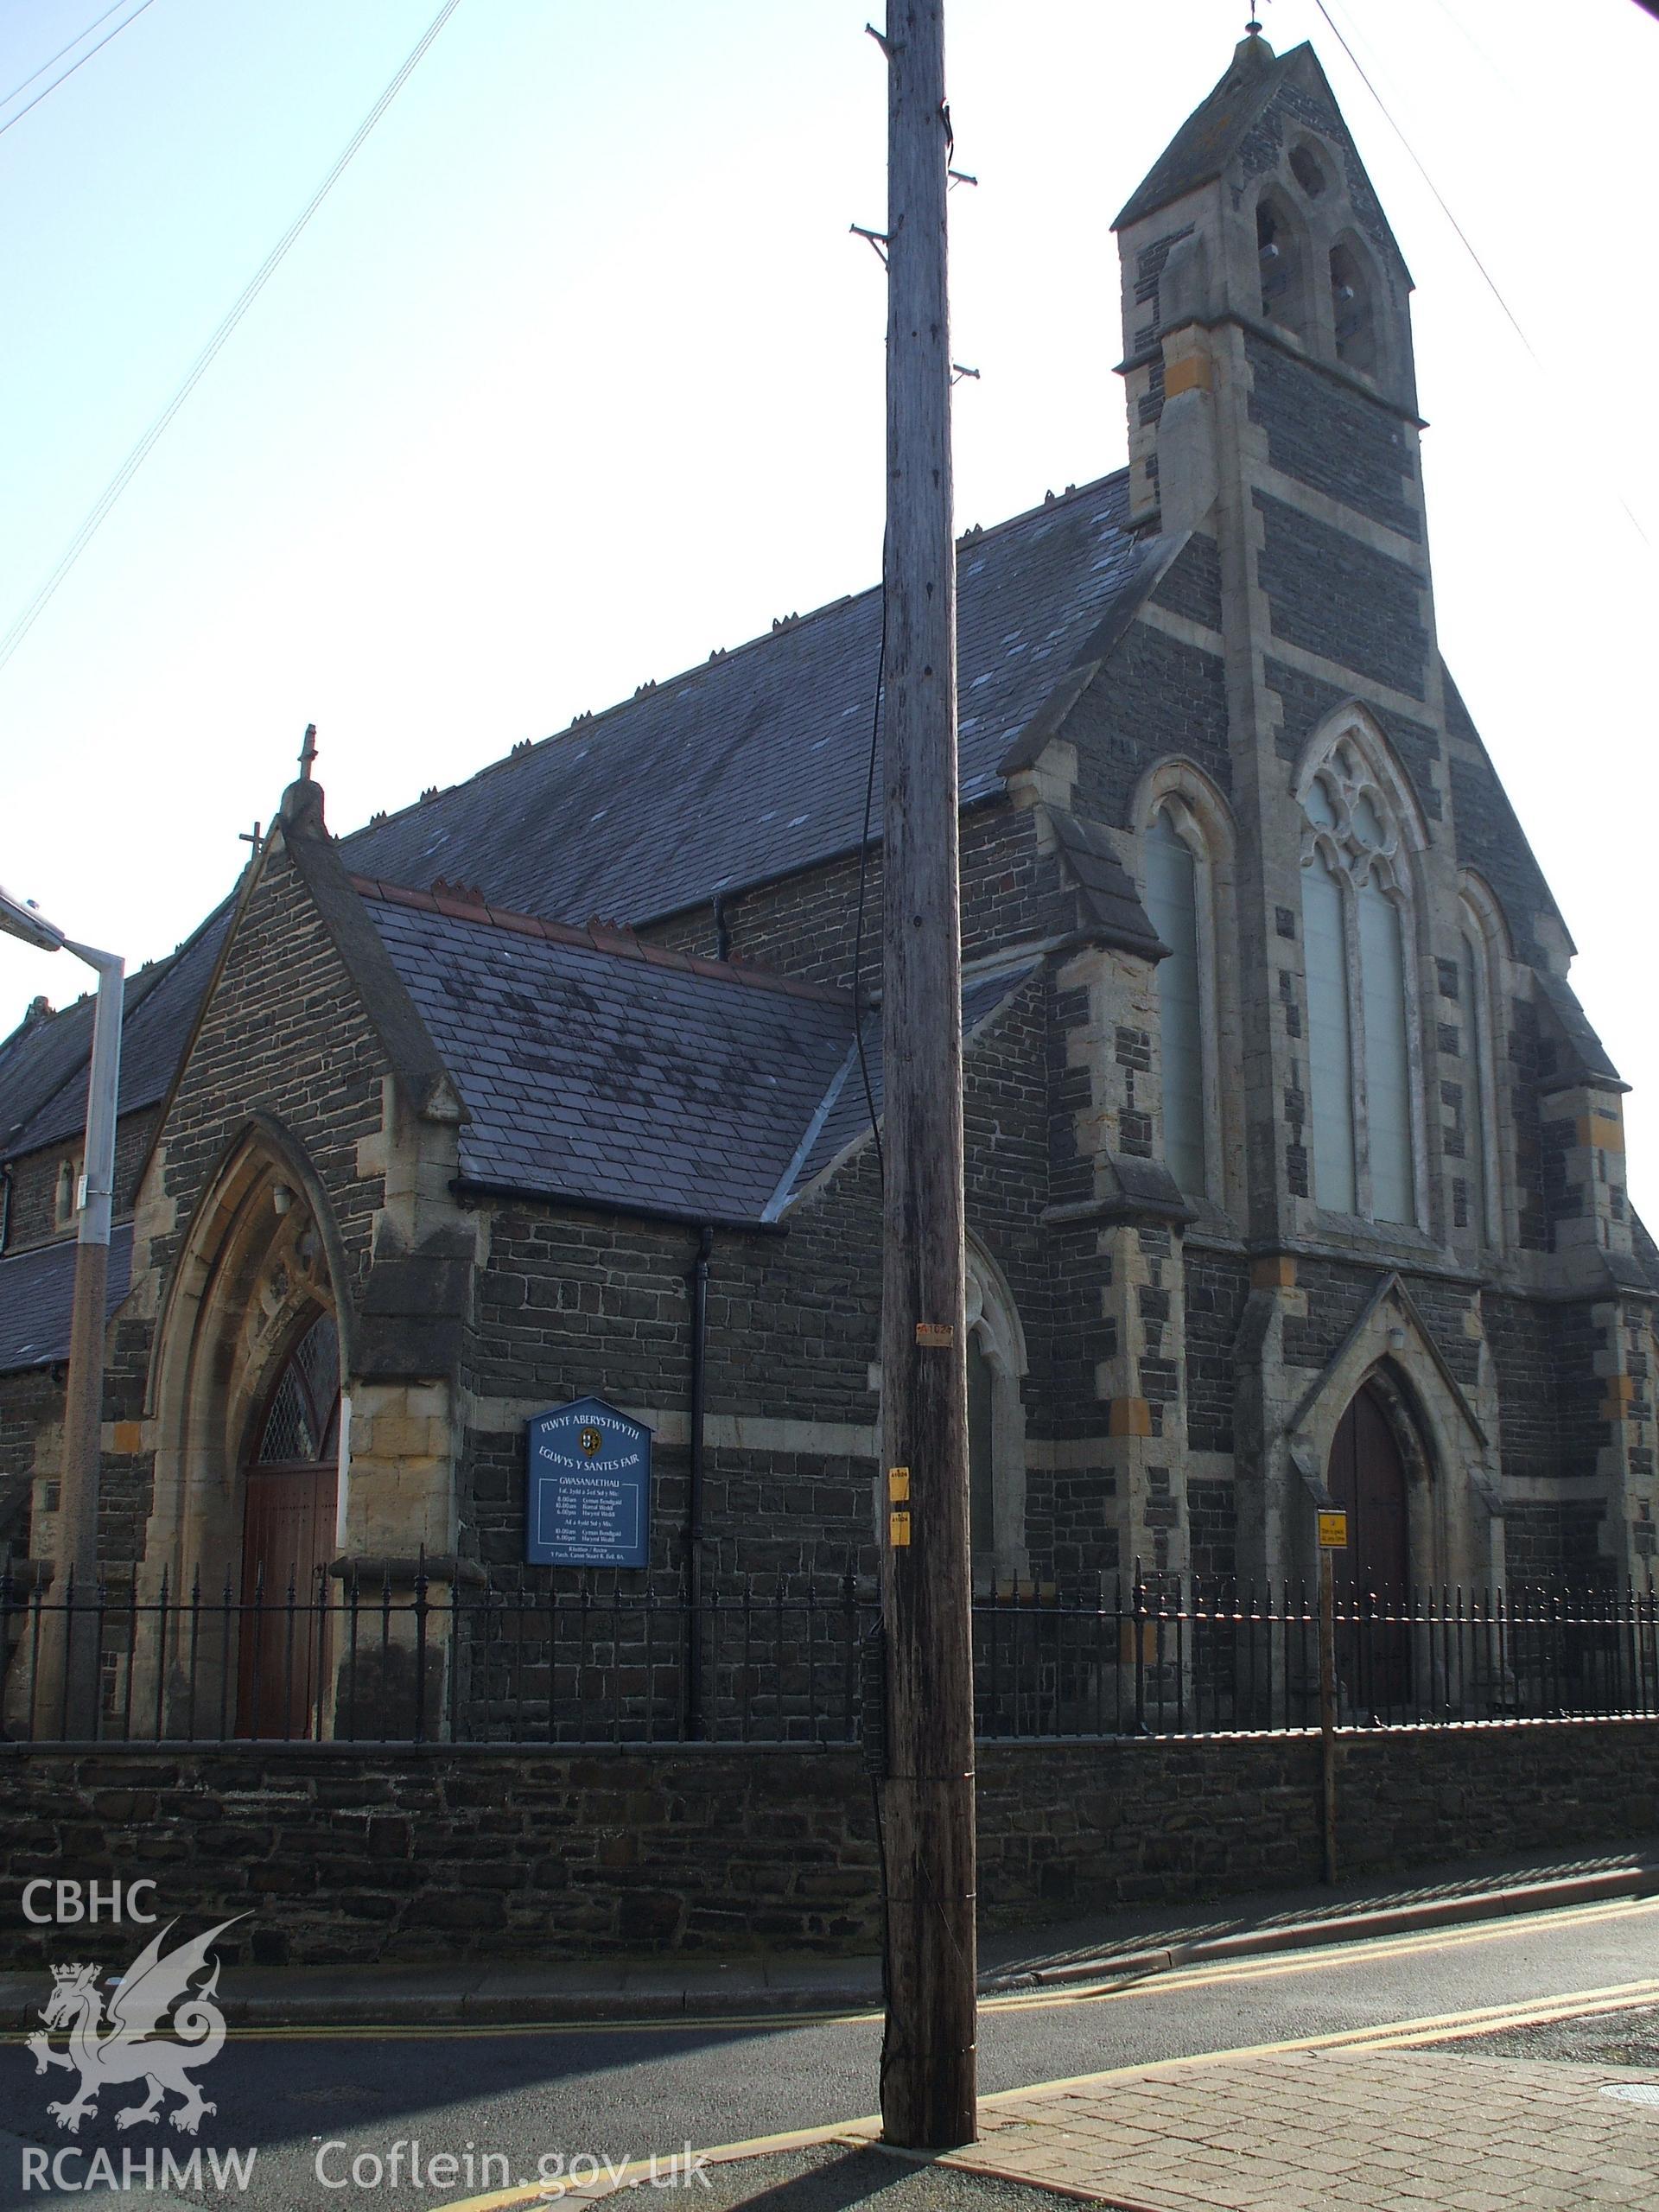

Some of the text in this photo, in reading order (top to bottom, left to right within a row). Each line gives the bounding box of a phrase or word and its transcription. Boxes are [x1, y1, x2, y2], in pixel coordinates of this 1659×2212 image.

[541, 1415, 640, 1440] PLWYF ABERYSTWYTH
[539, 1446, 640, 1471] EGLWYS Y SANTES FAIR
[559, 1477, 620, 1487] GWASANAETHAU
